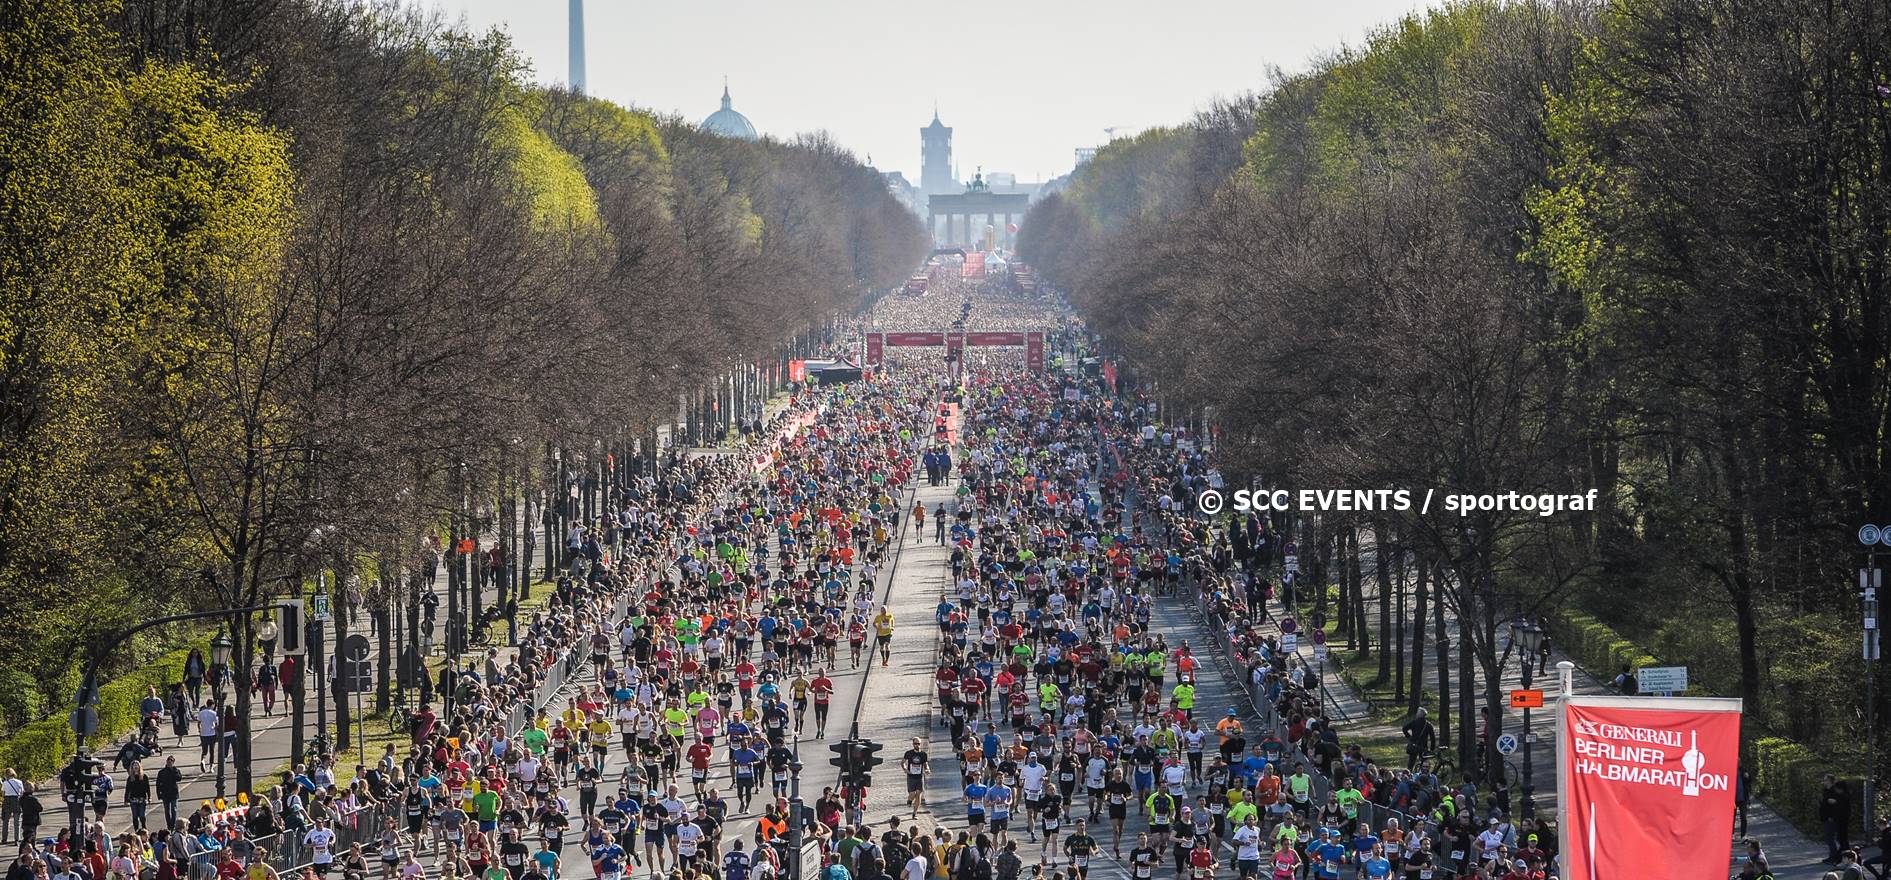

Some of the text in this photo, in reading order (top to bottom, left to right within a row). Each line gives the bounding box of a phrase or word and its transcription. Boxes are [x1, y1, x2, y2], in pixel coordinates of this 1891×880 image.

[1600, 723, 1683, 748] GENERALI
[1575, 737, 1665, 766] BERLINER
[1575, 757, 1729, 796] HALBMARATHON
